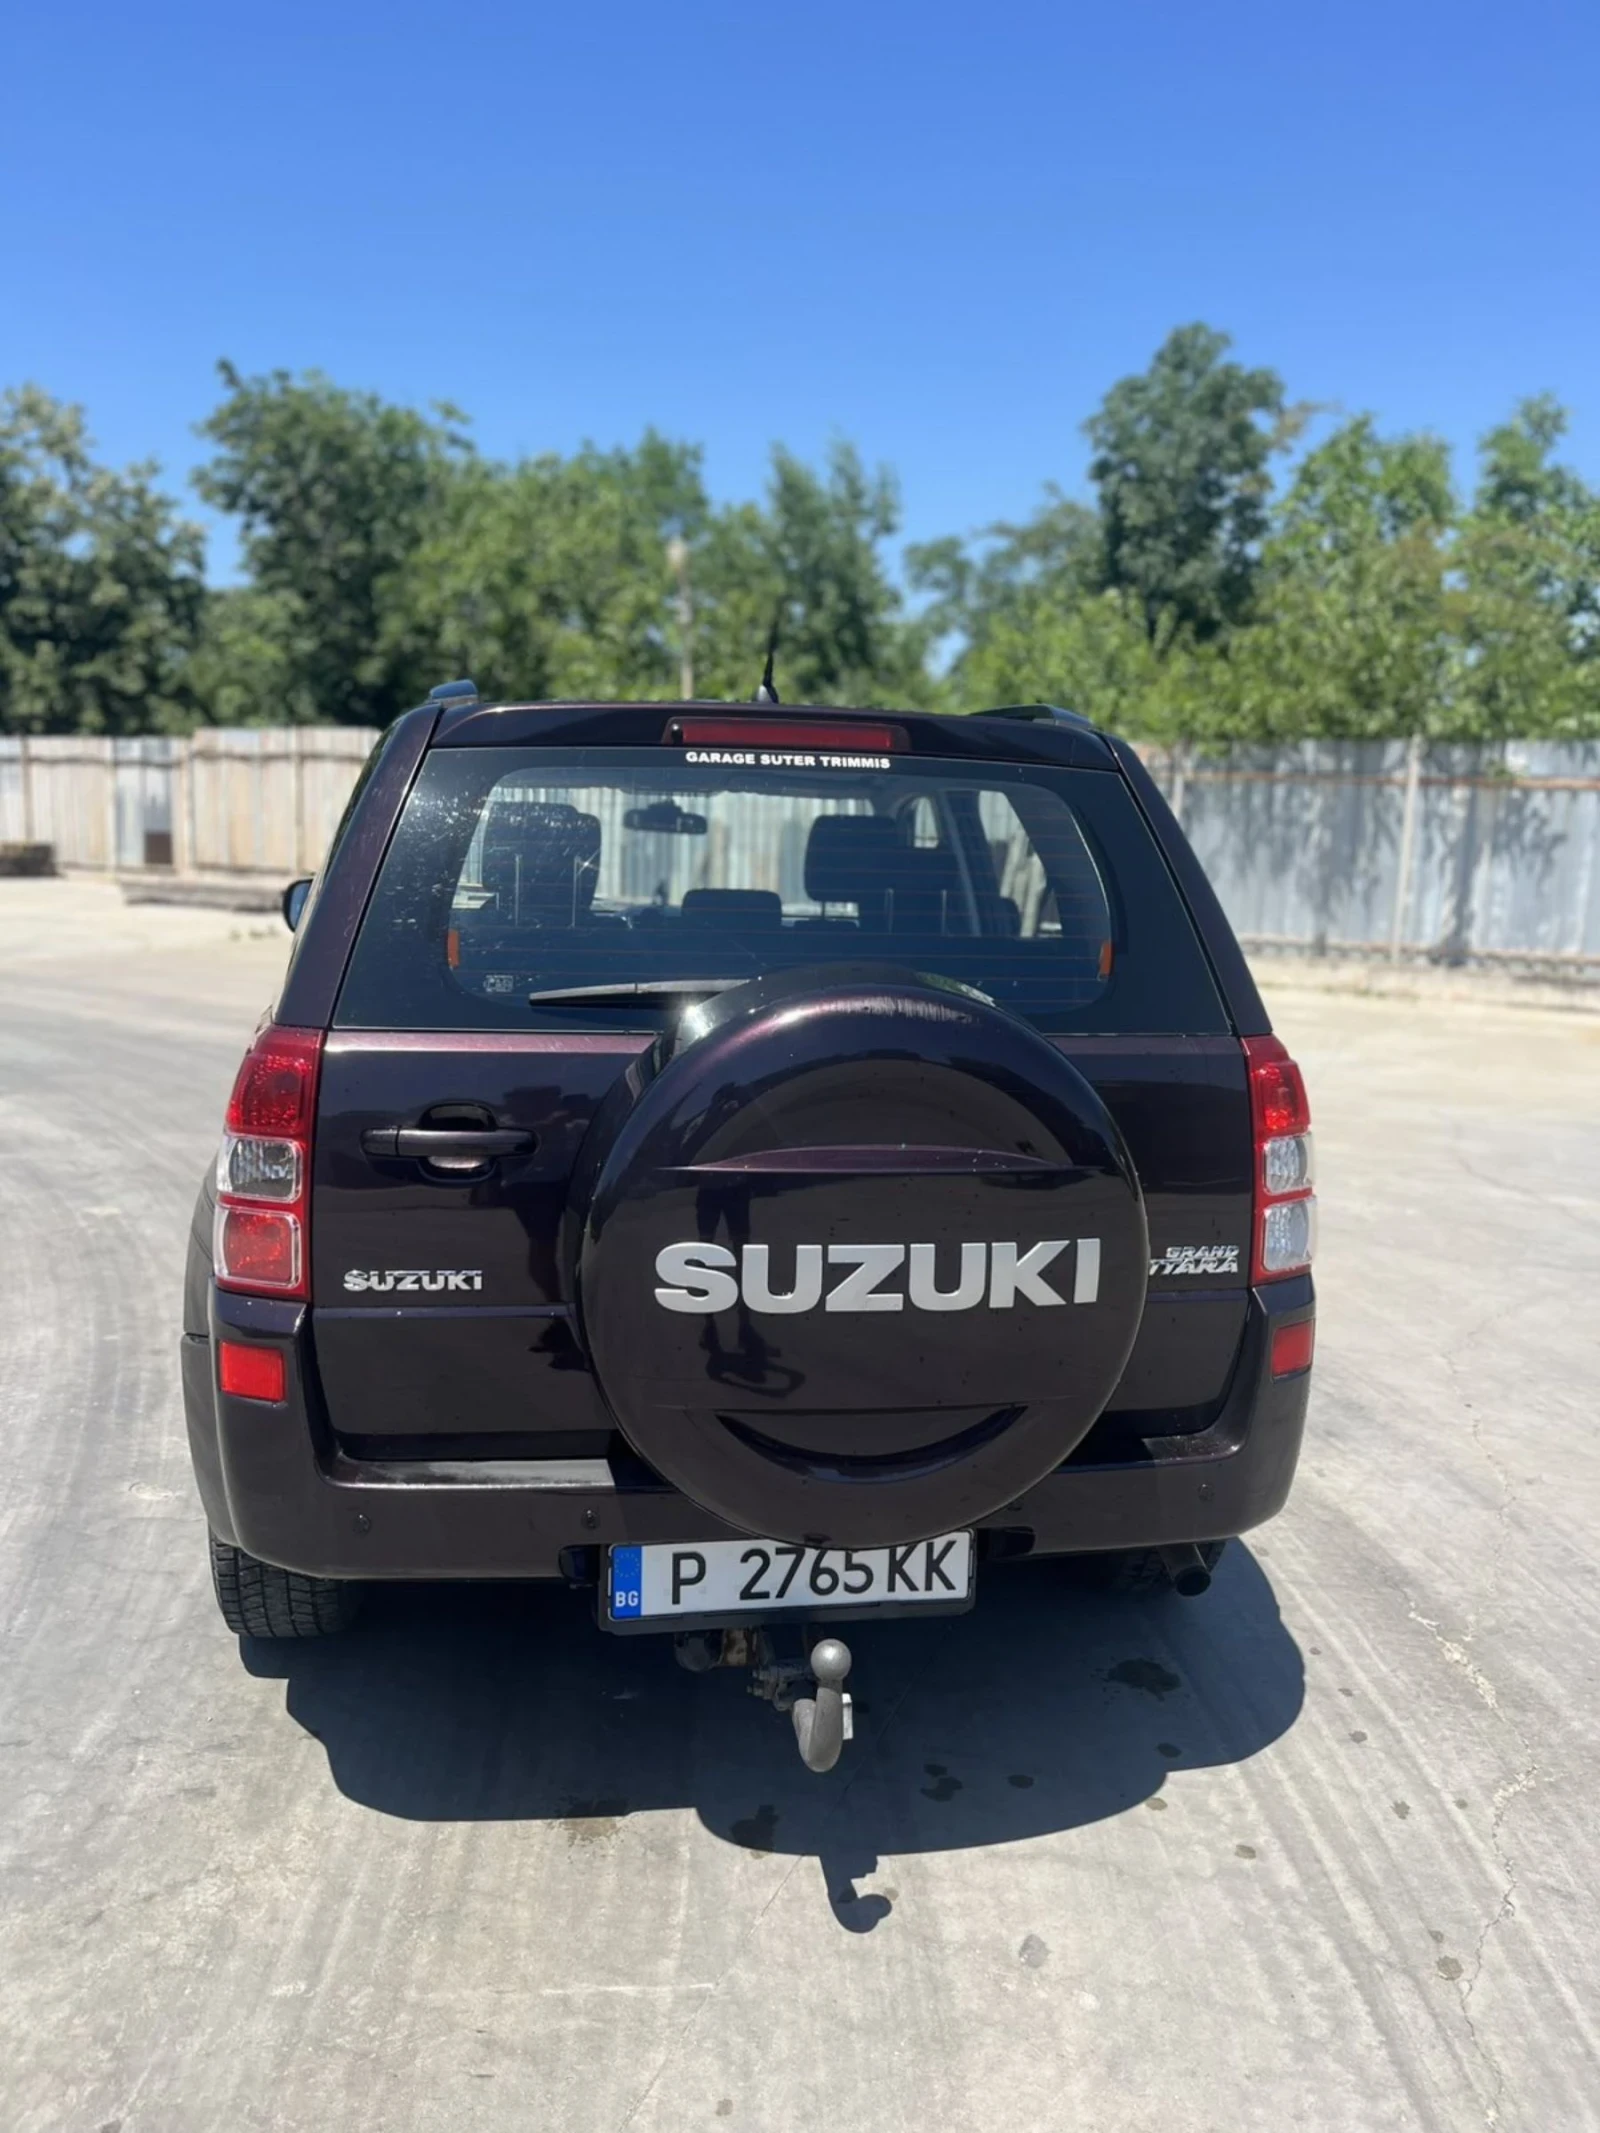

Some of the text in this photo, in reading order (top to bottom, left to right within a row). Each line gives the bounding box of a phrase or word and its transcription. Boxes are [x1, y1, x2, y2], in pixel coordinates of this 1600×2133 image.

[685, 751, 891, 769] GARAGE SUTER TRIMMIS
[1166, 1245, 1239, 1258] GRAND
[343, 1269, 483, 1291] SUZUKI
[654, 1238, 1100, 1314] SUZUKI
[671, 1551, 706, 1605] P
[615, 1591, 639, 1608] BG
